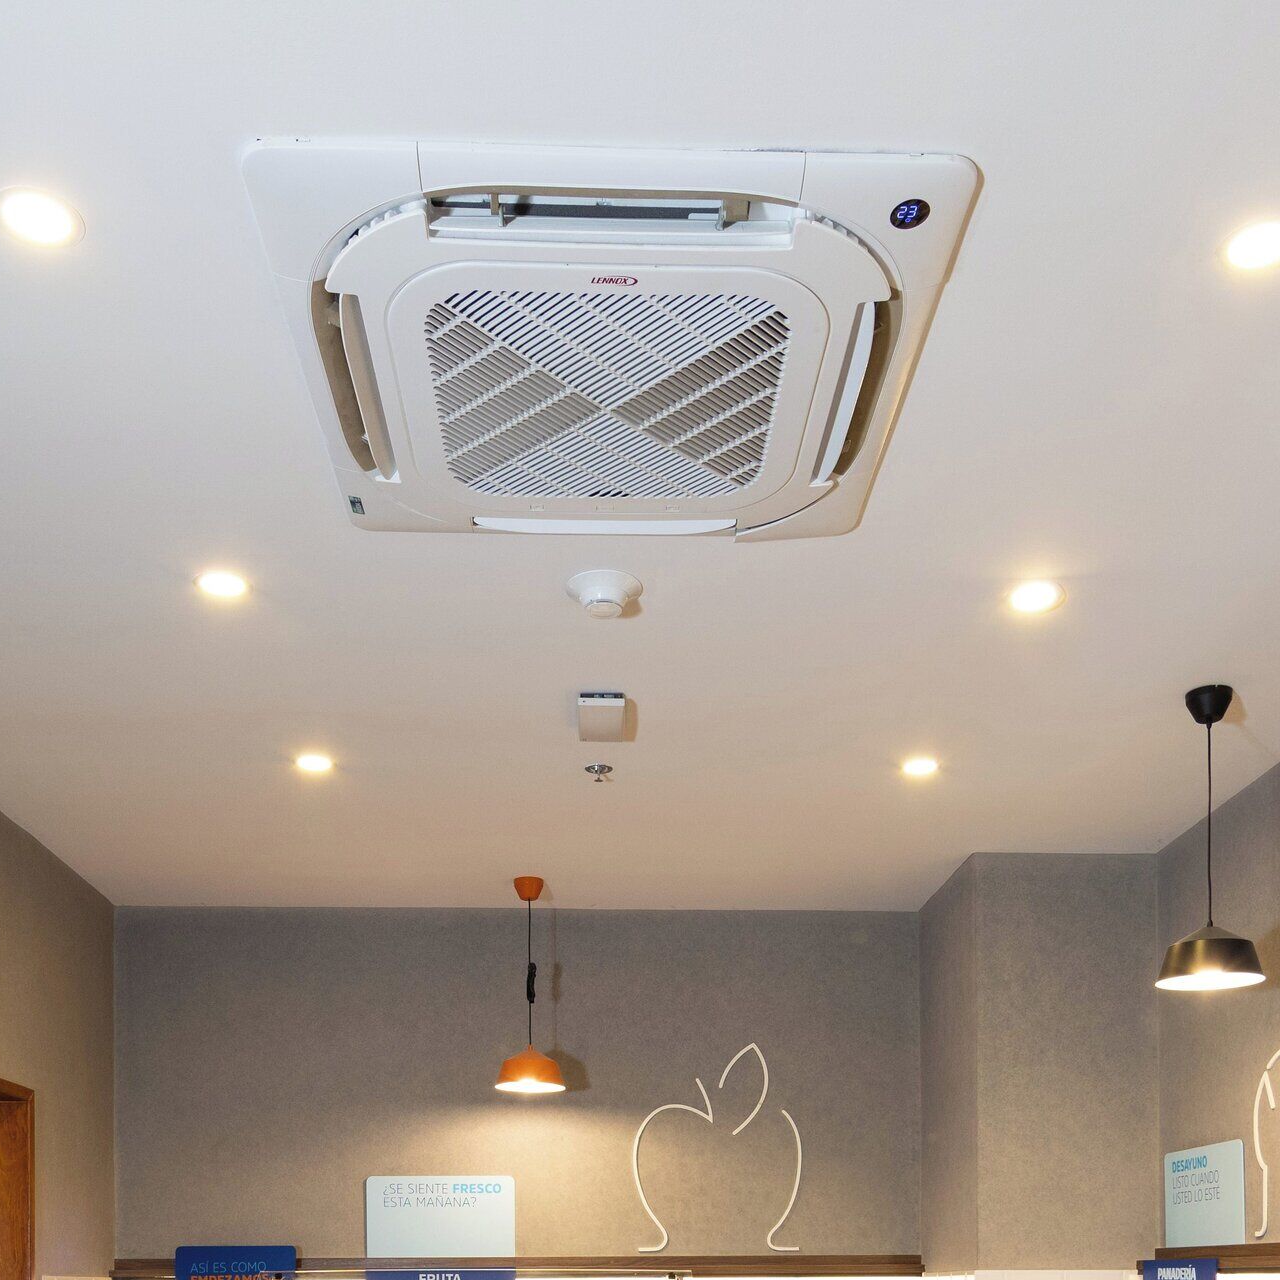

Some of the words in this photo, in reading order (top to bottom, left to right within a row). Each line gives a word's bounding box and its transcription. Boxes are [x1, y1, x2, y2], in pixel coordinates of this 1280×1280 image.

[897, 205, 918, 219] 23
[590, 276, 629, 285] LENNOX
[1171, 1155, 1208, 1174] DESAYUNO
[1172, 1171, 1189, 1190] LISTO
[1190, 1169, 1220, 1188] CUANDO
[383, 1182, 404, 1196] ¿SE
[407, 1183, 449, 1195] SIENTE
[452, 1183, 502, 1194] FRESCO
[383, 1197, 412, 1208] ESTA
[416, 1194, 477, 1208] MAÑANA?
[1172, 1188, 1193, 1206] USTED
[1194, 1188, 1204, 1203] LO
[190, 1260, 209, 1274] ASÍ
[213, 1262, 227, 1273] ES
[231, 1261, 267, 1273] COMO
[1157, 1264, 1197, 1280] PANADERÍA
